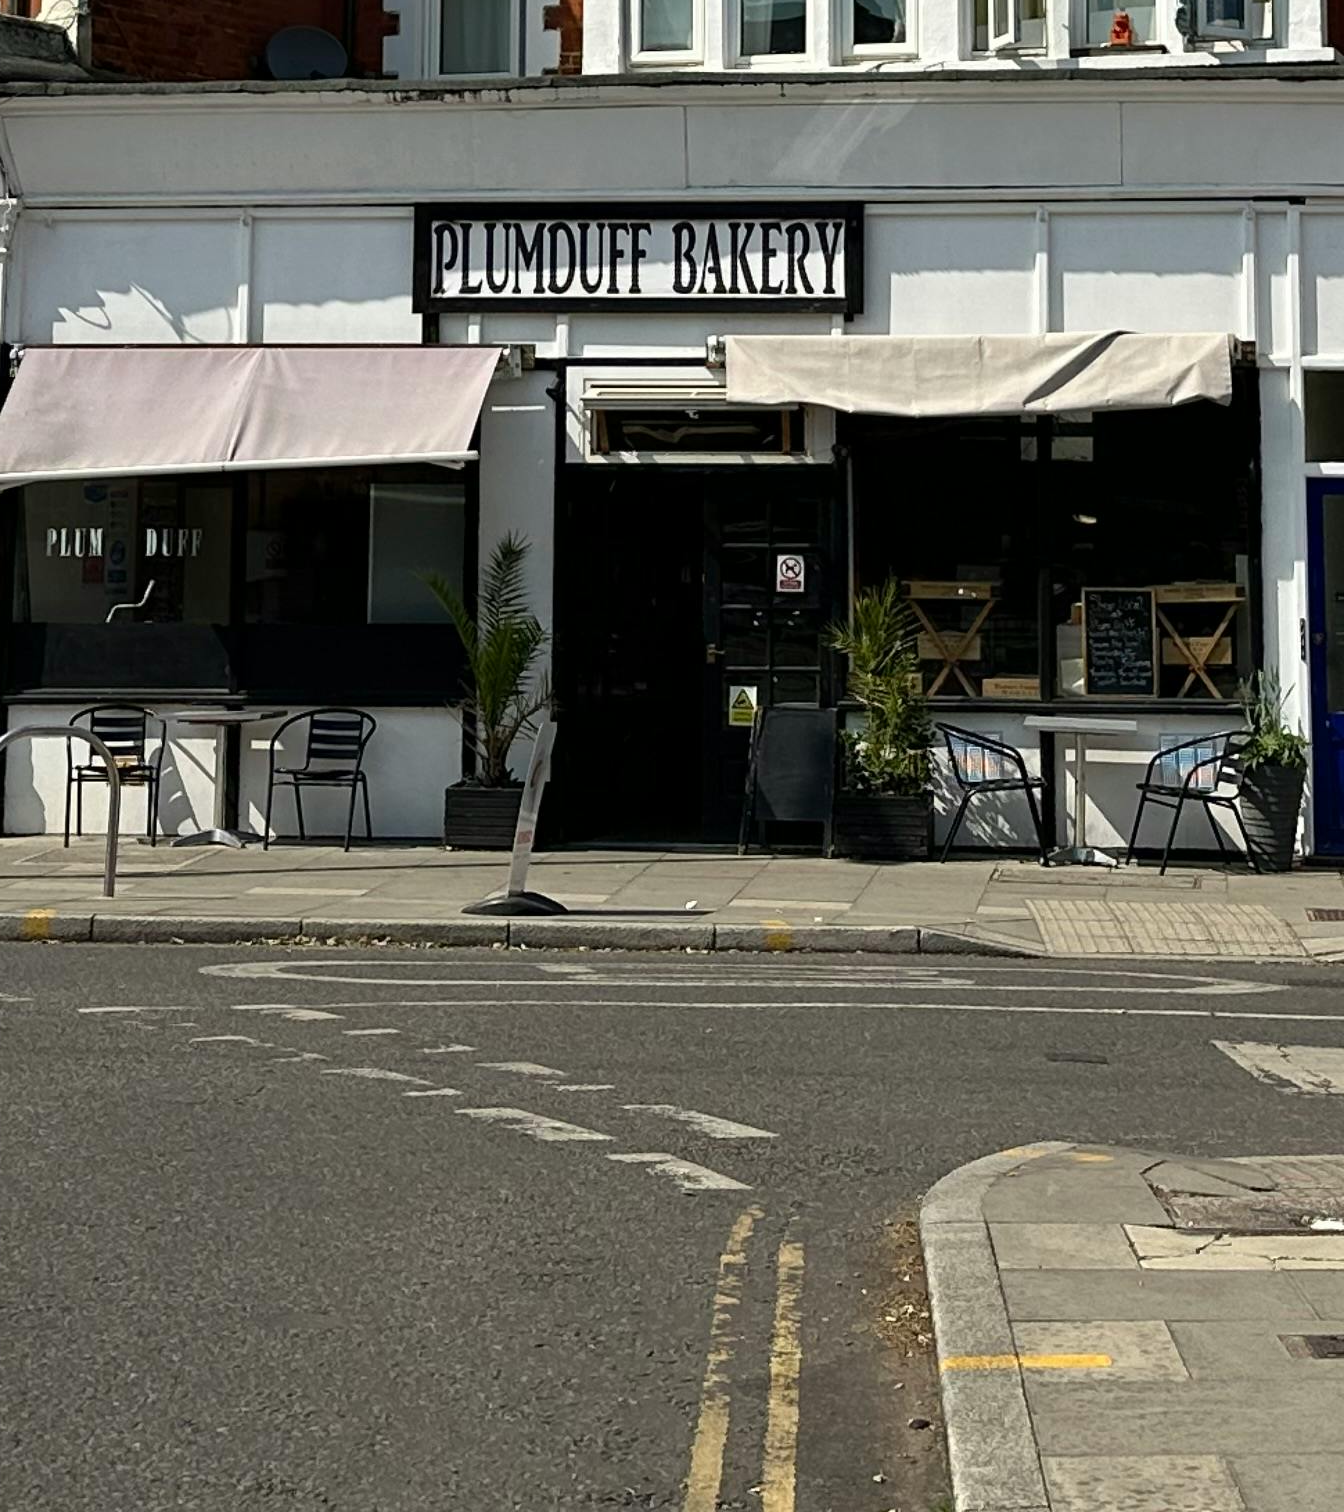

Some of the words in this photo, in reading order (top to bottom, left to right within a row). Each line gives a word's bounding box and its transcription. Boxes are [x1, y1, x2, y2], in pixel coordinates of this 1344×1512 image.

[432, 221, 652, 295] PLUMDUFF
[671, 221, 843, 295] BAKERY
[45, 527, 105, 557] PLUM
[144, 527, 203, 558] DUFF
